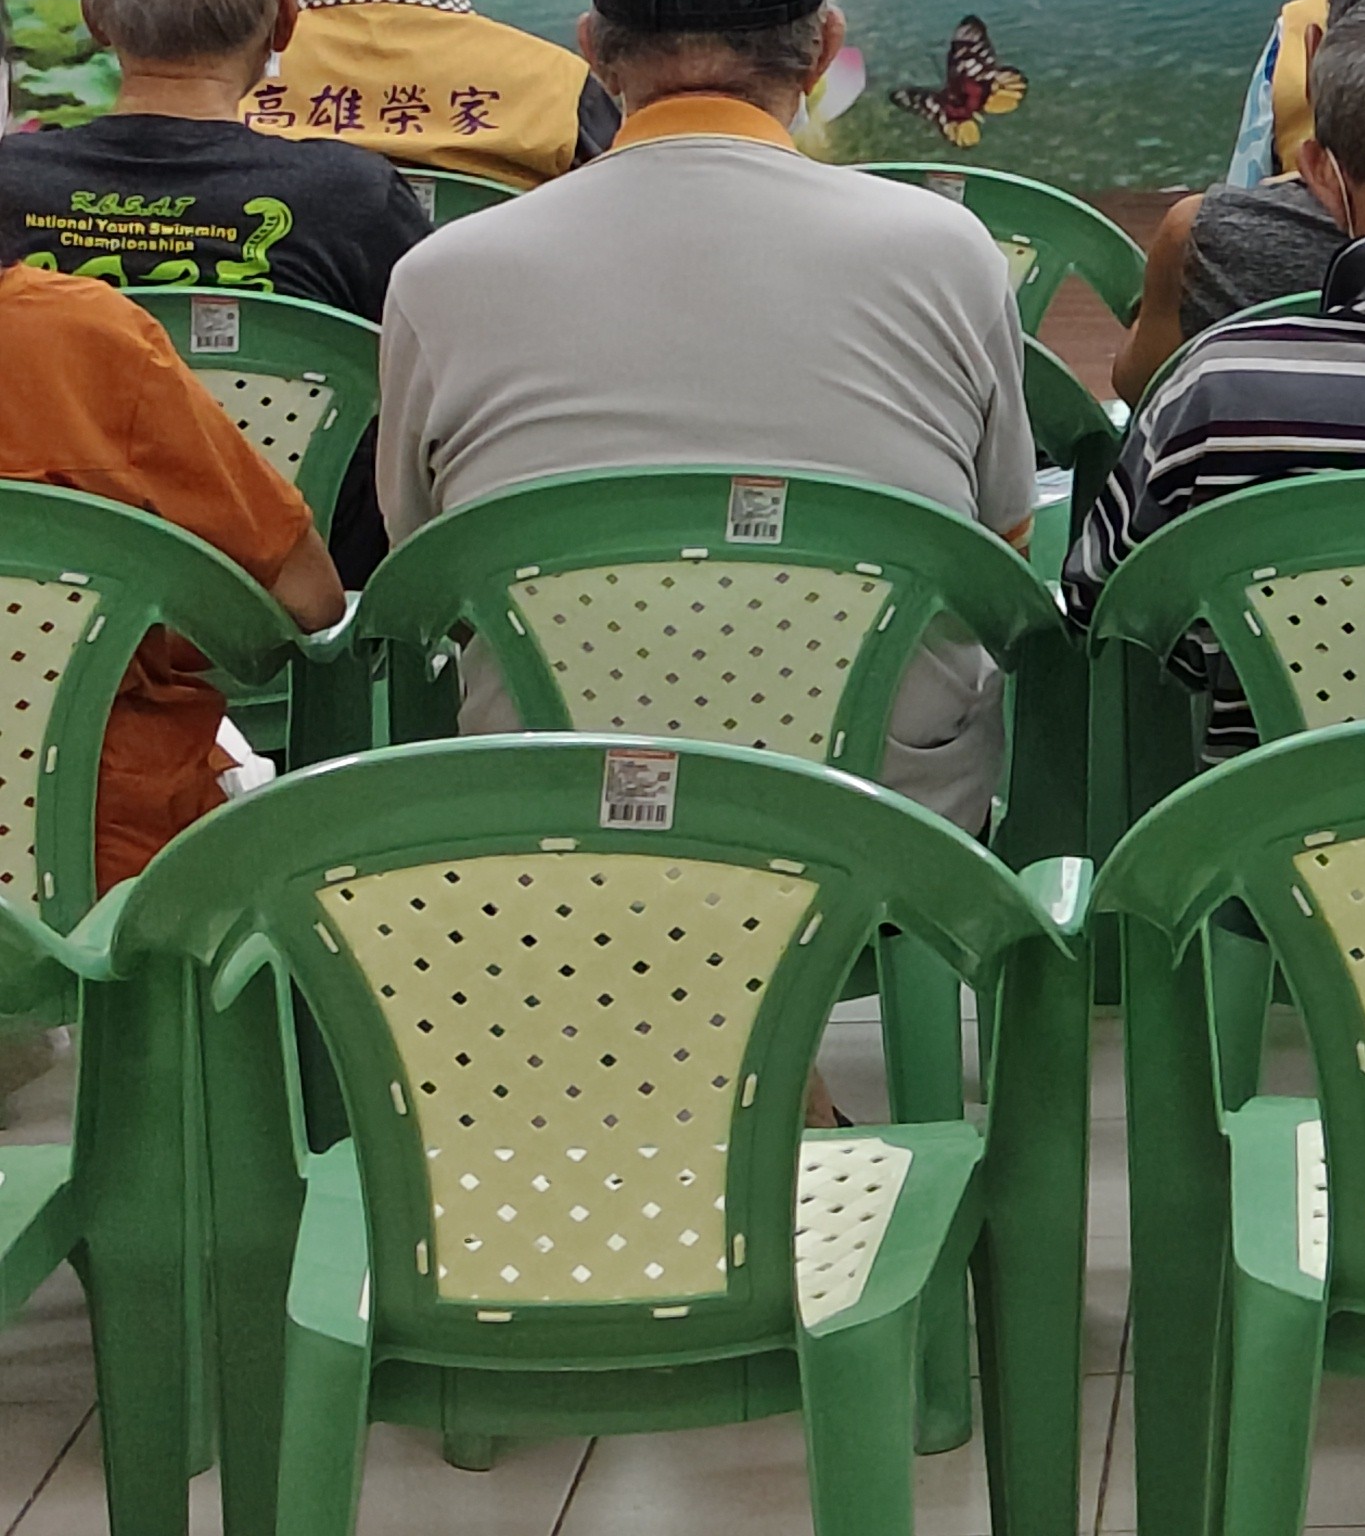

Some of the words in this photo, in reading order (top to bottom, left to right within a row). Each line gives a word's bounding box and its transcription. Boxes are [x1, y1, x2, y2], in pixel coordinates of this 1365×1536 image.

[245, 84, 500, 135] 高雄榮家
[25, 214, 92, 231] National
[97, 219, 145, 235] Youth
[150, 223, 237, 241] Swimming
[60, 232, 194, 253] Championships
